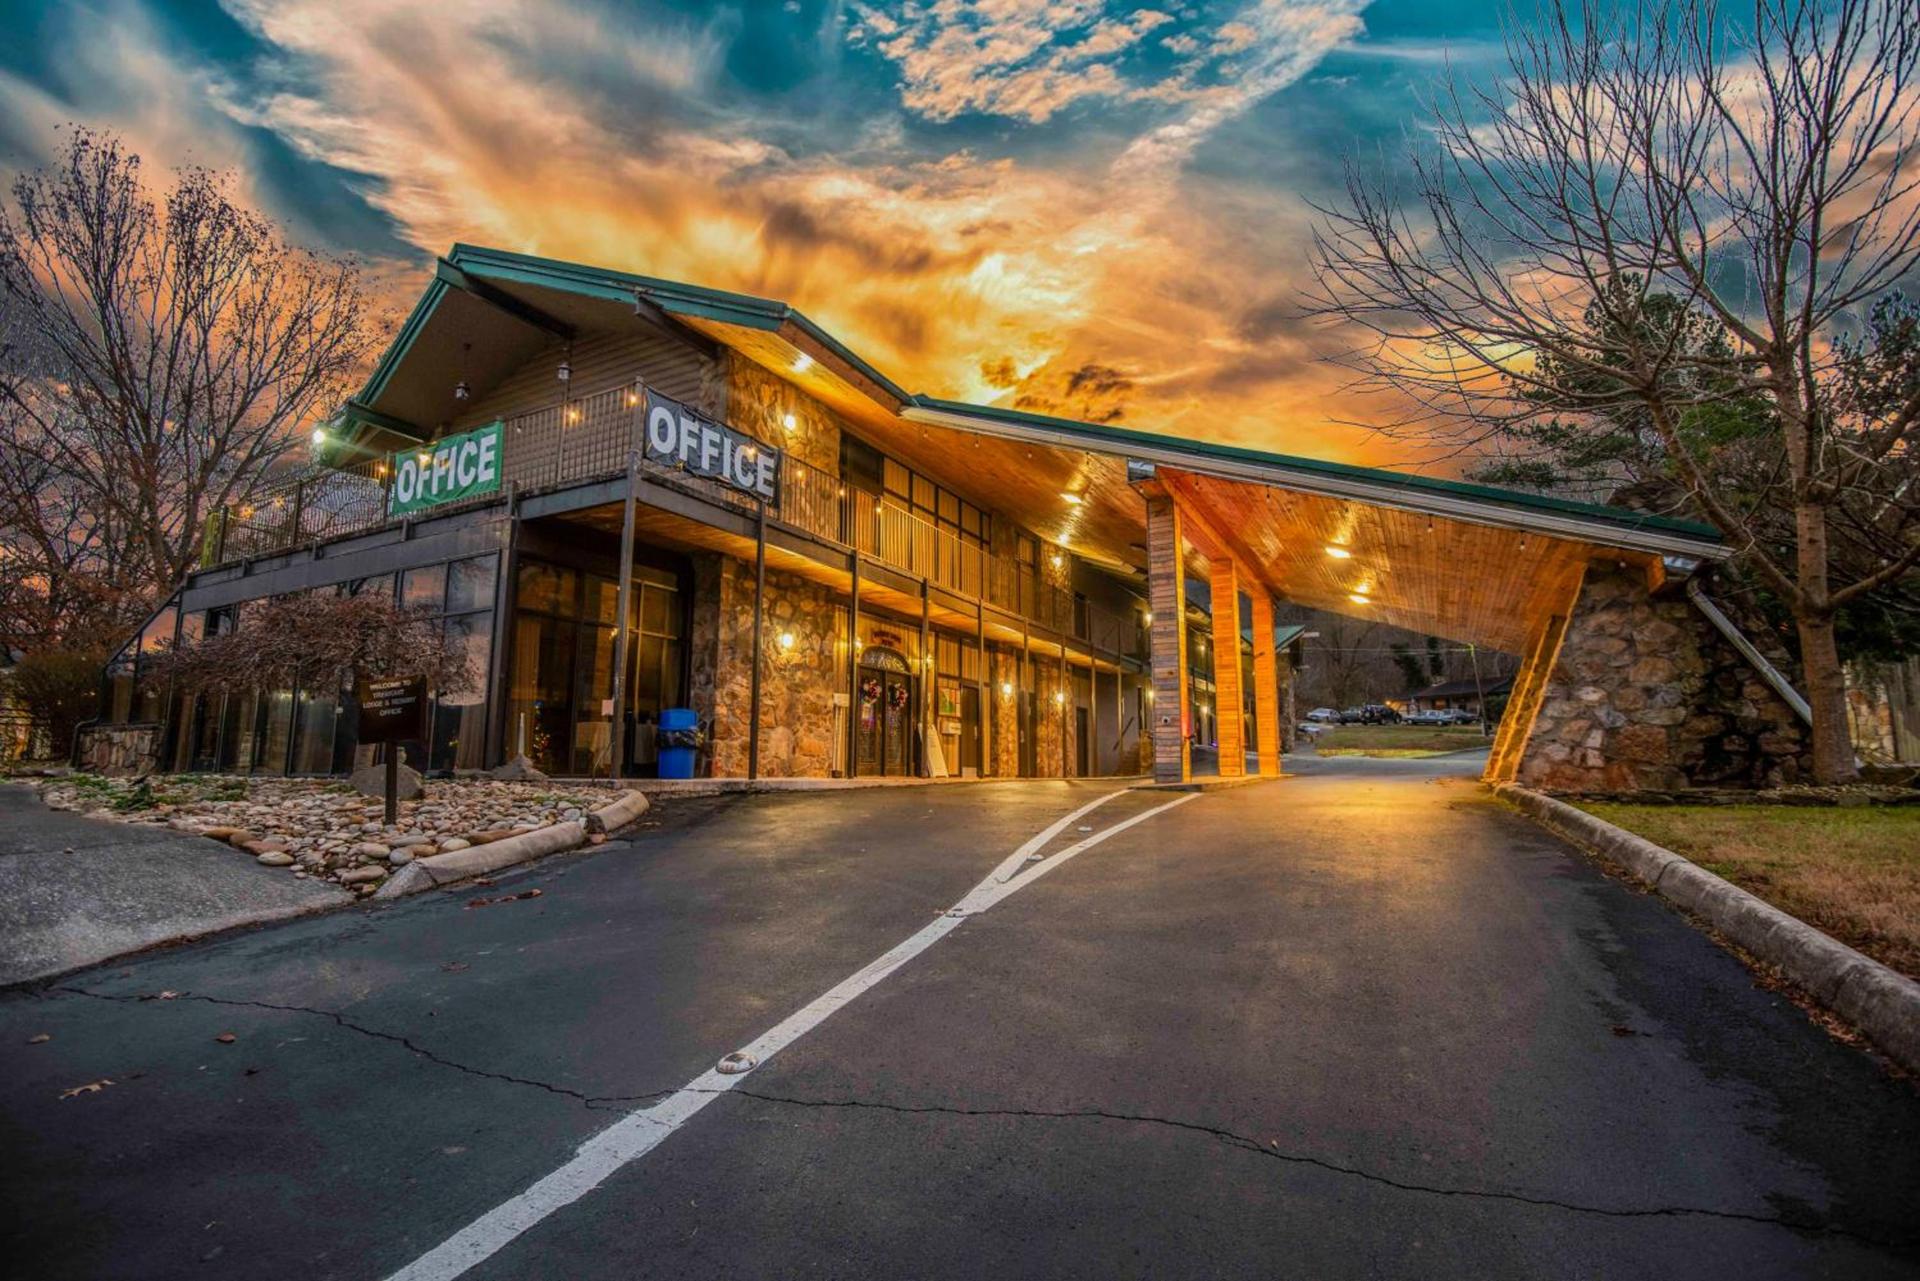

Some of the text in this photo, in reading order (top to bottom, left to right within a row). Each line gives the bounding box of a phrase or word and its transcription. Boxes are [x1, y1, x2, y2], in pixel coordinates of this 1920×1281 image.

[398, 433, 497, 503] OFFICE
[649, 406, 775, 497] OFFICE
[369, 681, 401, 690] WELCOME
[379, 708, 403, 716] OFFICE
